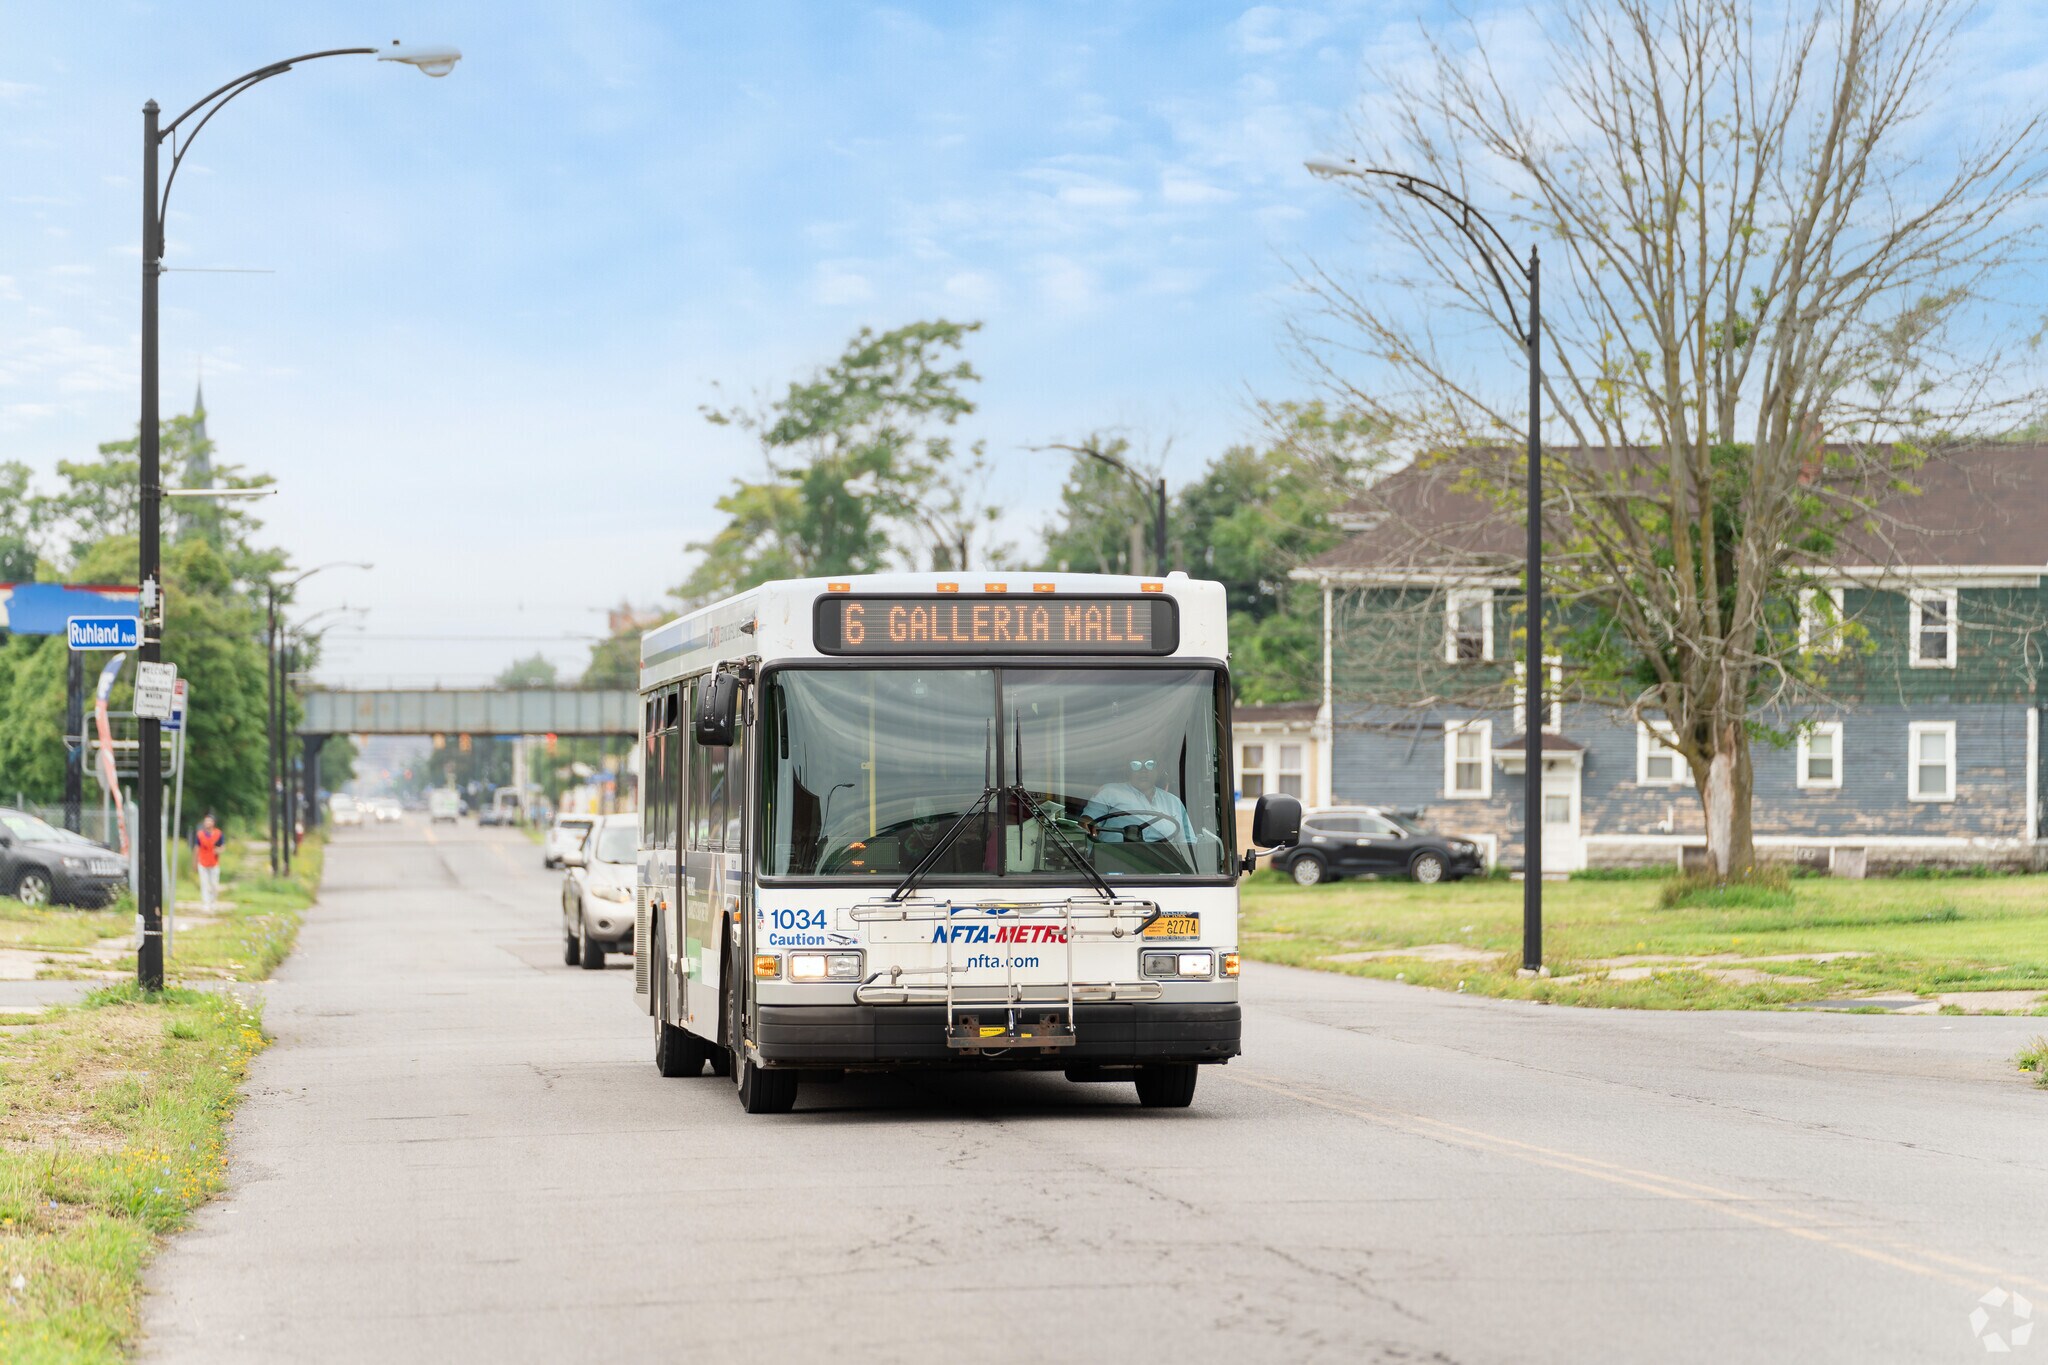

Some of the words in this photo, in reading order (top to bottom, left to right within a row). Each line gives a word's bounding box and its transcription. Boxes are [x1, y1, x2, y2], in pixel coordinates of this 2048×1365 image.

[71, 622, 119, 644] Ruhland
[121, 631, 136, 644] Ave
[846, 603, 865, 645] 6
[889, 605, 1049, 642] GALLERIA
[1064, 605, 1144, 642] MALL
[771, 909, 827, 930] 1034
[769, 932, 825, 946] Caution
[967, 953, 1039, 968] nfta.com
